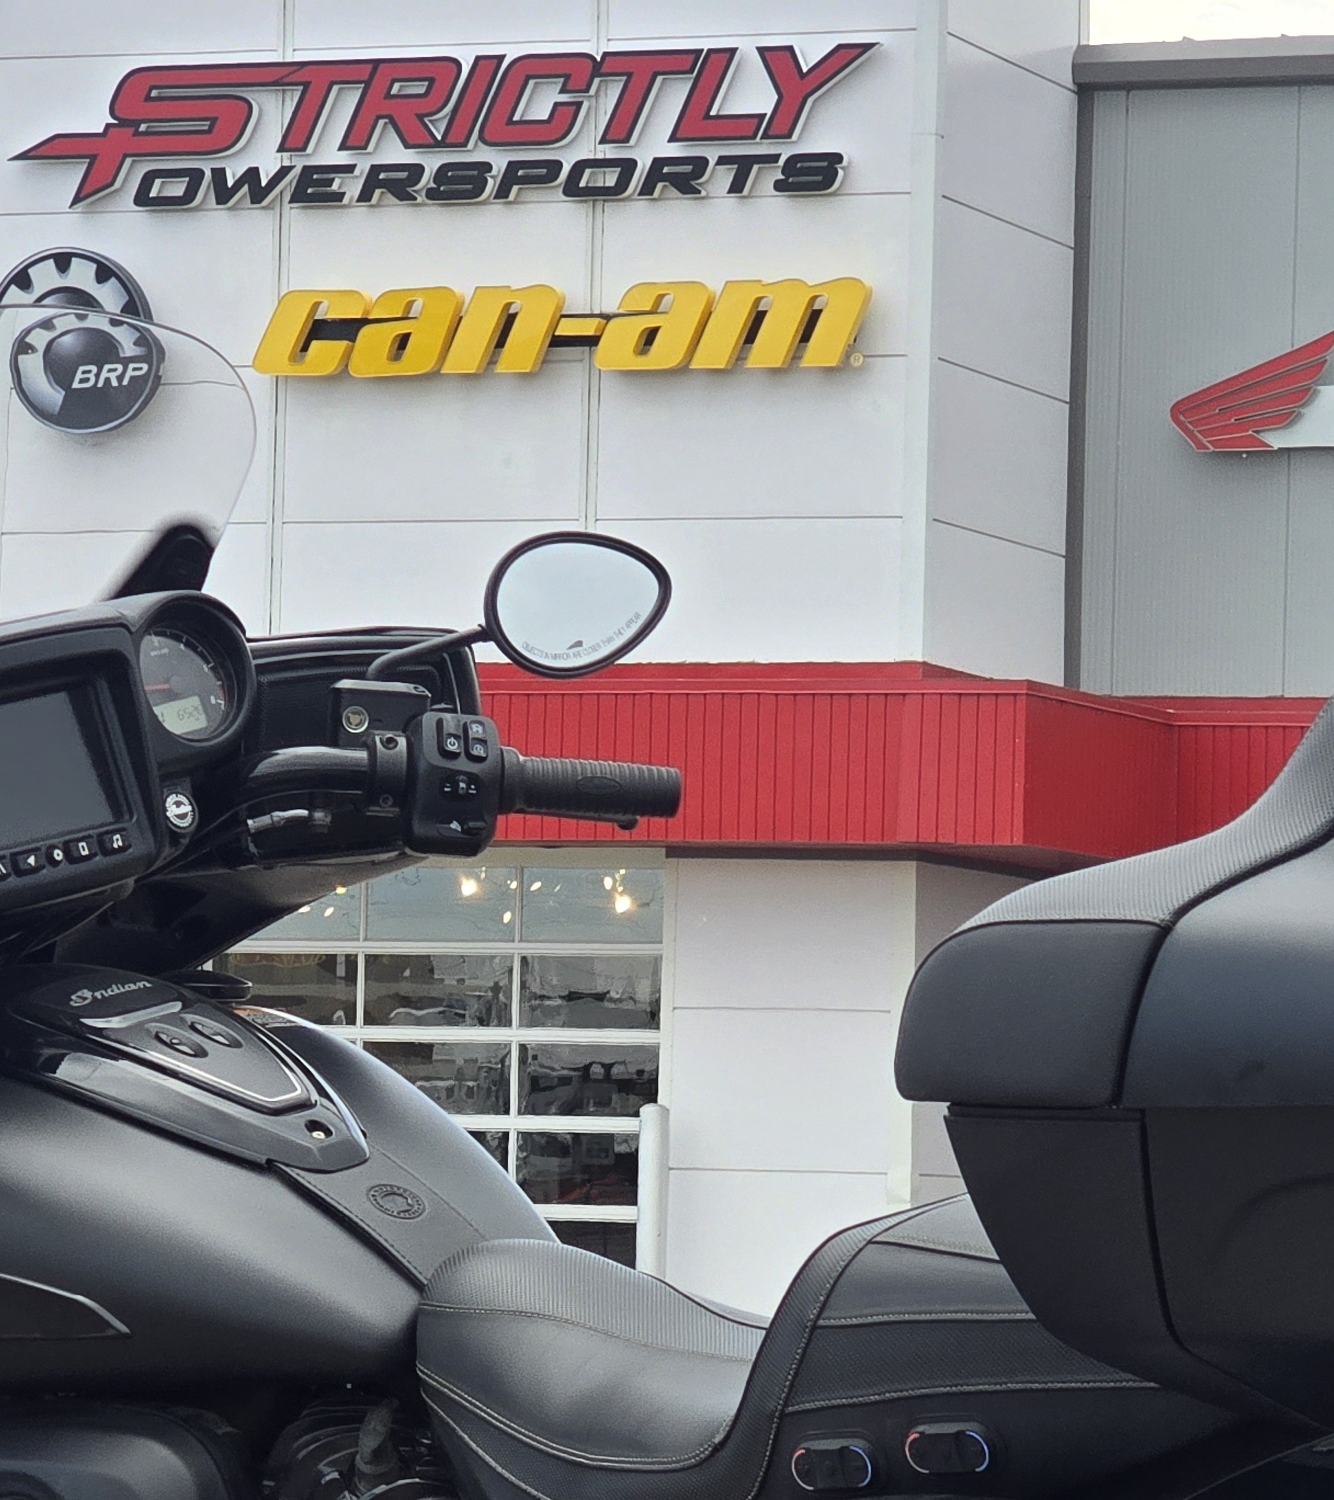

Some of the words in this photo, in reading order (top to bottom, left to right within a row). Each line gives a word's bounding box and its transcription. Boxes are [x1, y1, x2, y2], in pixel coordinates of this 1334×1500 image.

[8, 42, 880, 160] STRICTLY
[71, 363, 149, 389] BRP
[69, 980, 153, 1007] Indian
